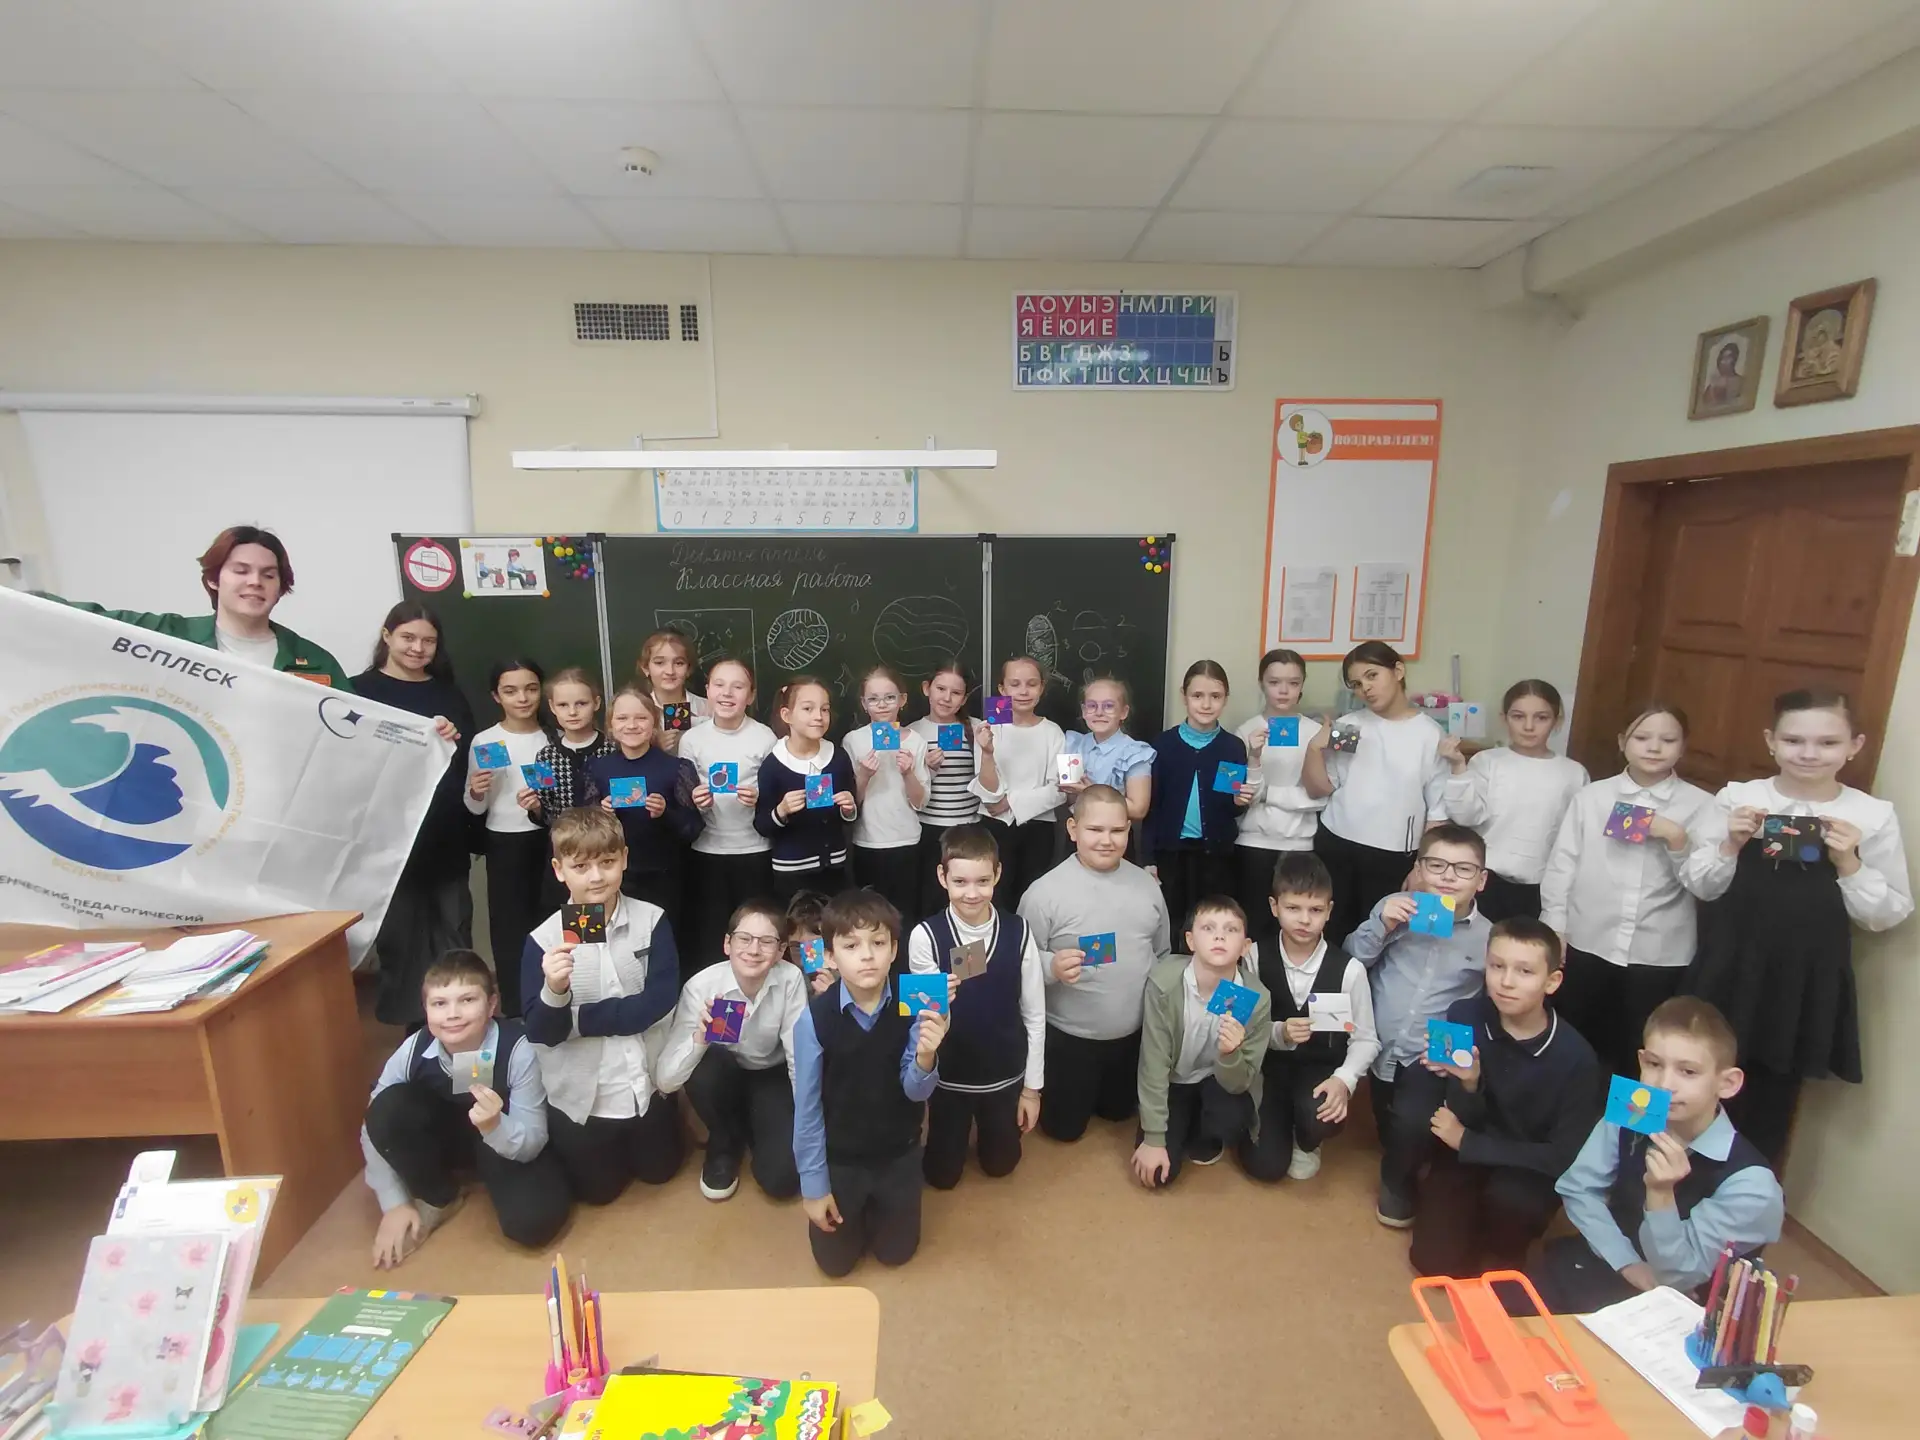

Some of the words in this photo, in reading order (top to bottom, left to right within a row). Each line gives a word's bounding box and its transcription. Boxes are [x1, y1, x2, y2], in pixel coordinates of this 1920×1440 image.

[1219, 346, 1229, 362] Ь
[1334, 434, 1434, 447] ПОЗДРАВЛЯЕМ!
[673, 511, 682, 525] 0
[701, 511, 707, 525] 1
[723, 511, 732, 525] 2
[749, 511, 757, 525] 3
[774, 511, 783, 525] 4
[796, 511, 806, 525] 5
[823, 511, 832, 525] 6
[847, 511, 856, 525] 7
[873, 511, 881, 525] 8
[896, 511, 905, 525] 9
[676, 566, 783, 591] Классная
[112, 636, 238, 689] ВСПЛЕСК
[73, 898, 204, 923] ПЕДАГОГИЧЕСКИЙ
